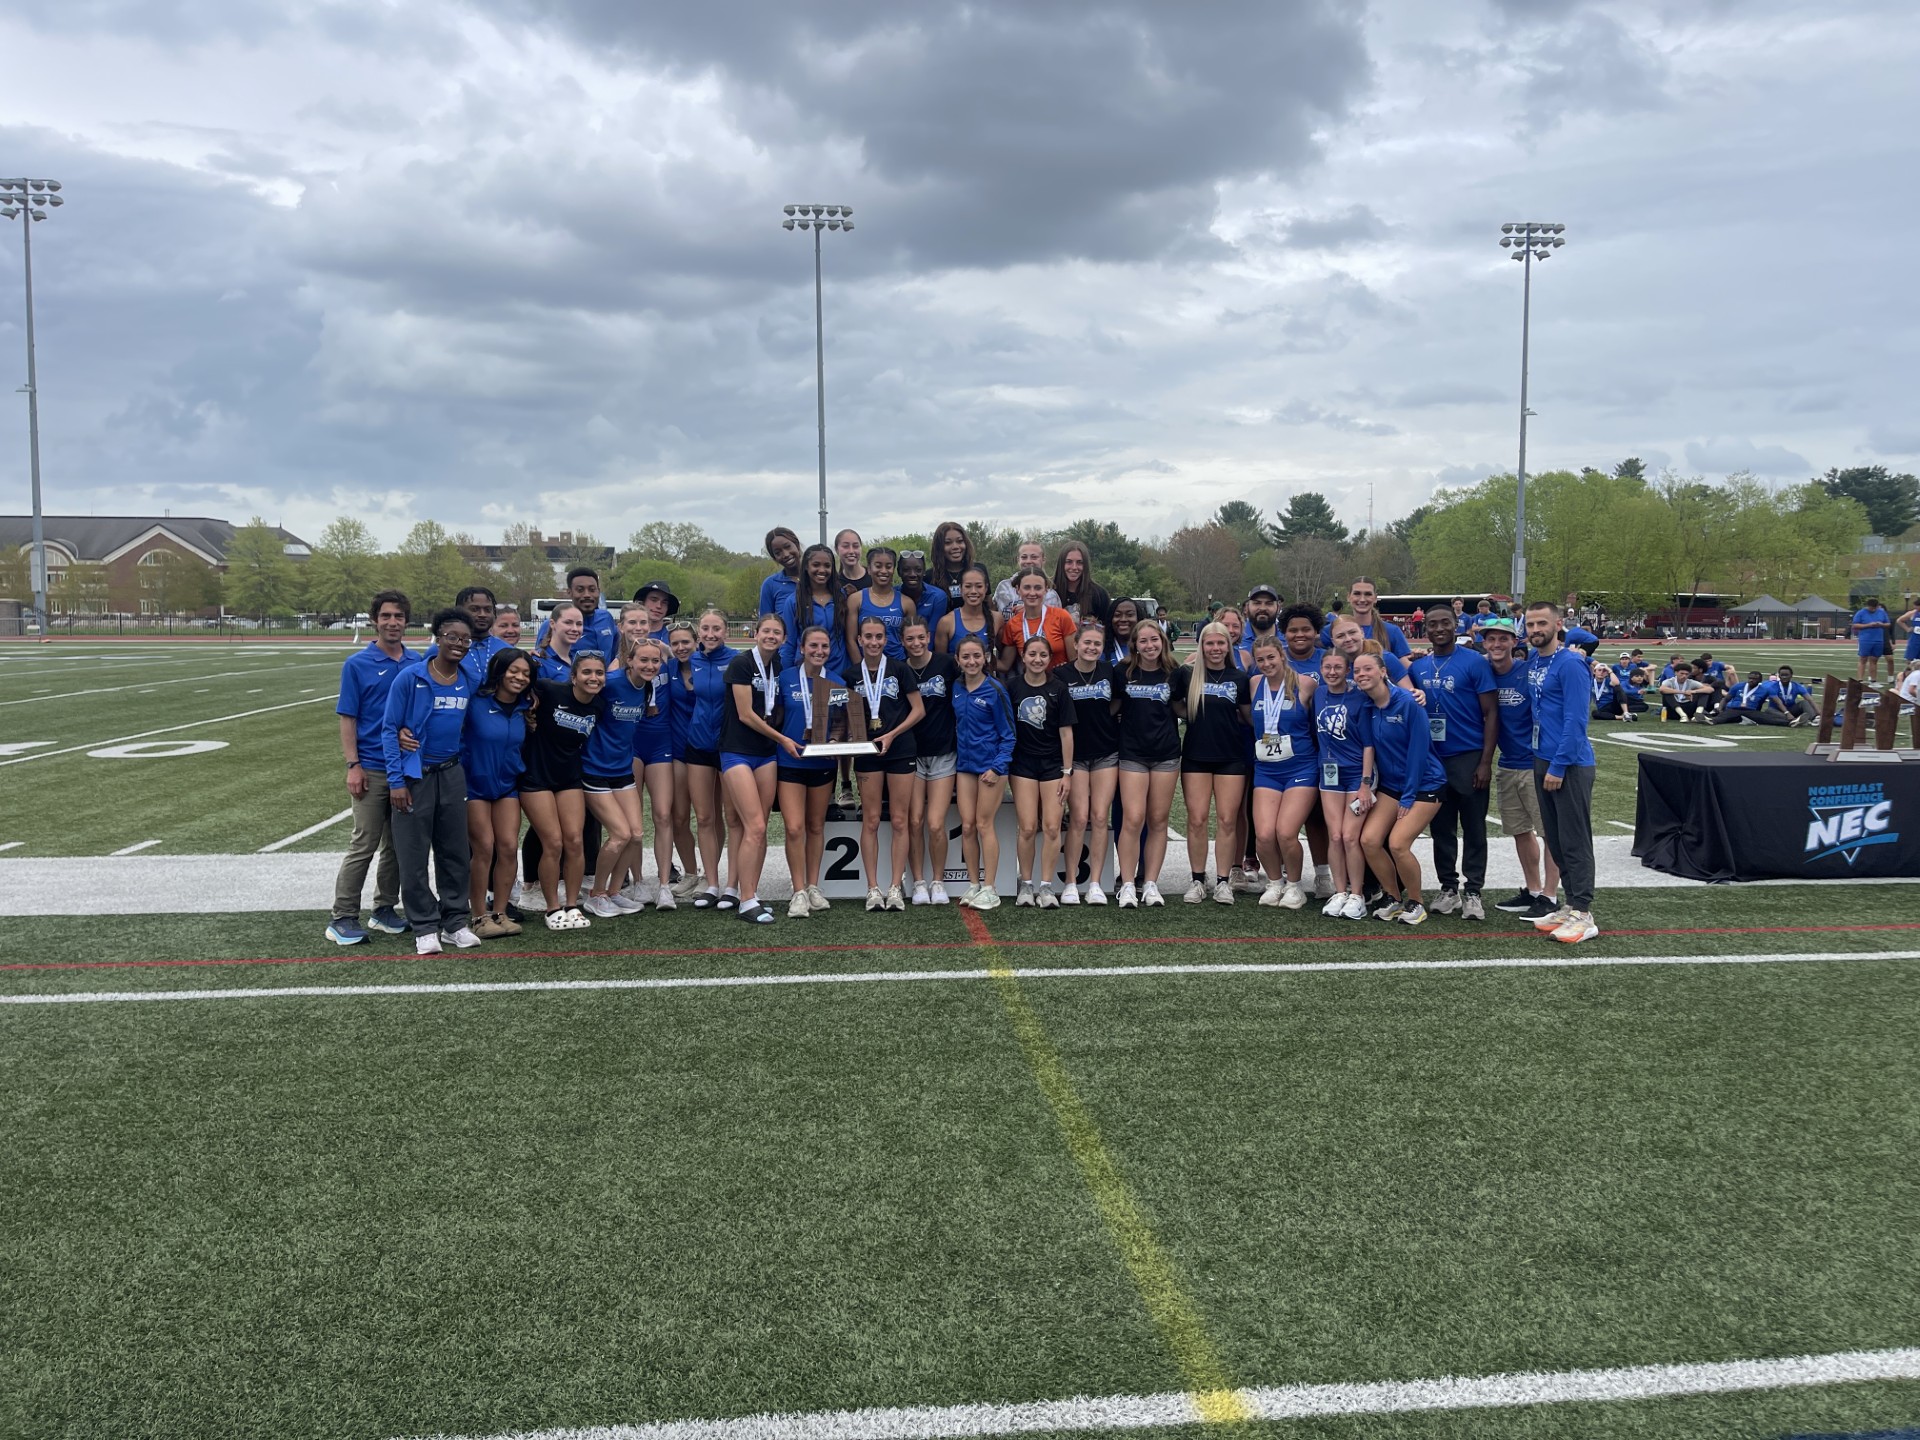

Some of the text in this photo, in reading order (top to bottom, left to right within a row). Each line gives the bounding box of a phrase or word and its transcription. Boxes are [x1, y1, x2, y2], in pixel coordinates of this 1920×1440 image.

[829, 693, 848, 702] NEC
[1265, 743, 1283, 757] 24
[1808, 782, 1884, 796] NORTHEAST
[1809, 792, 1884, 806] CONFERENCE
[1803, 799, 1892, 853] NEC
[824, 836, 860, 880] 2
[1056, 843, 1091, 885] 3
